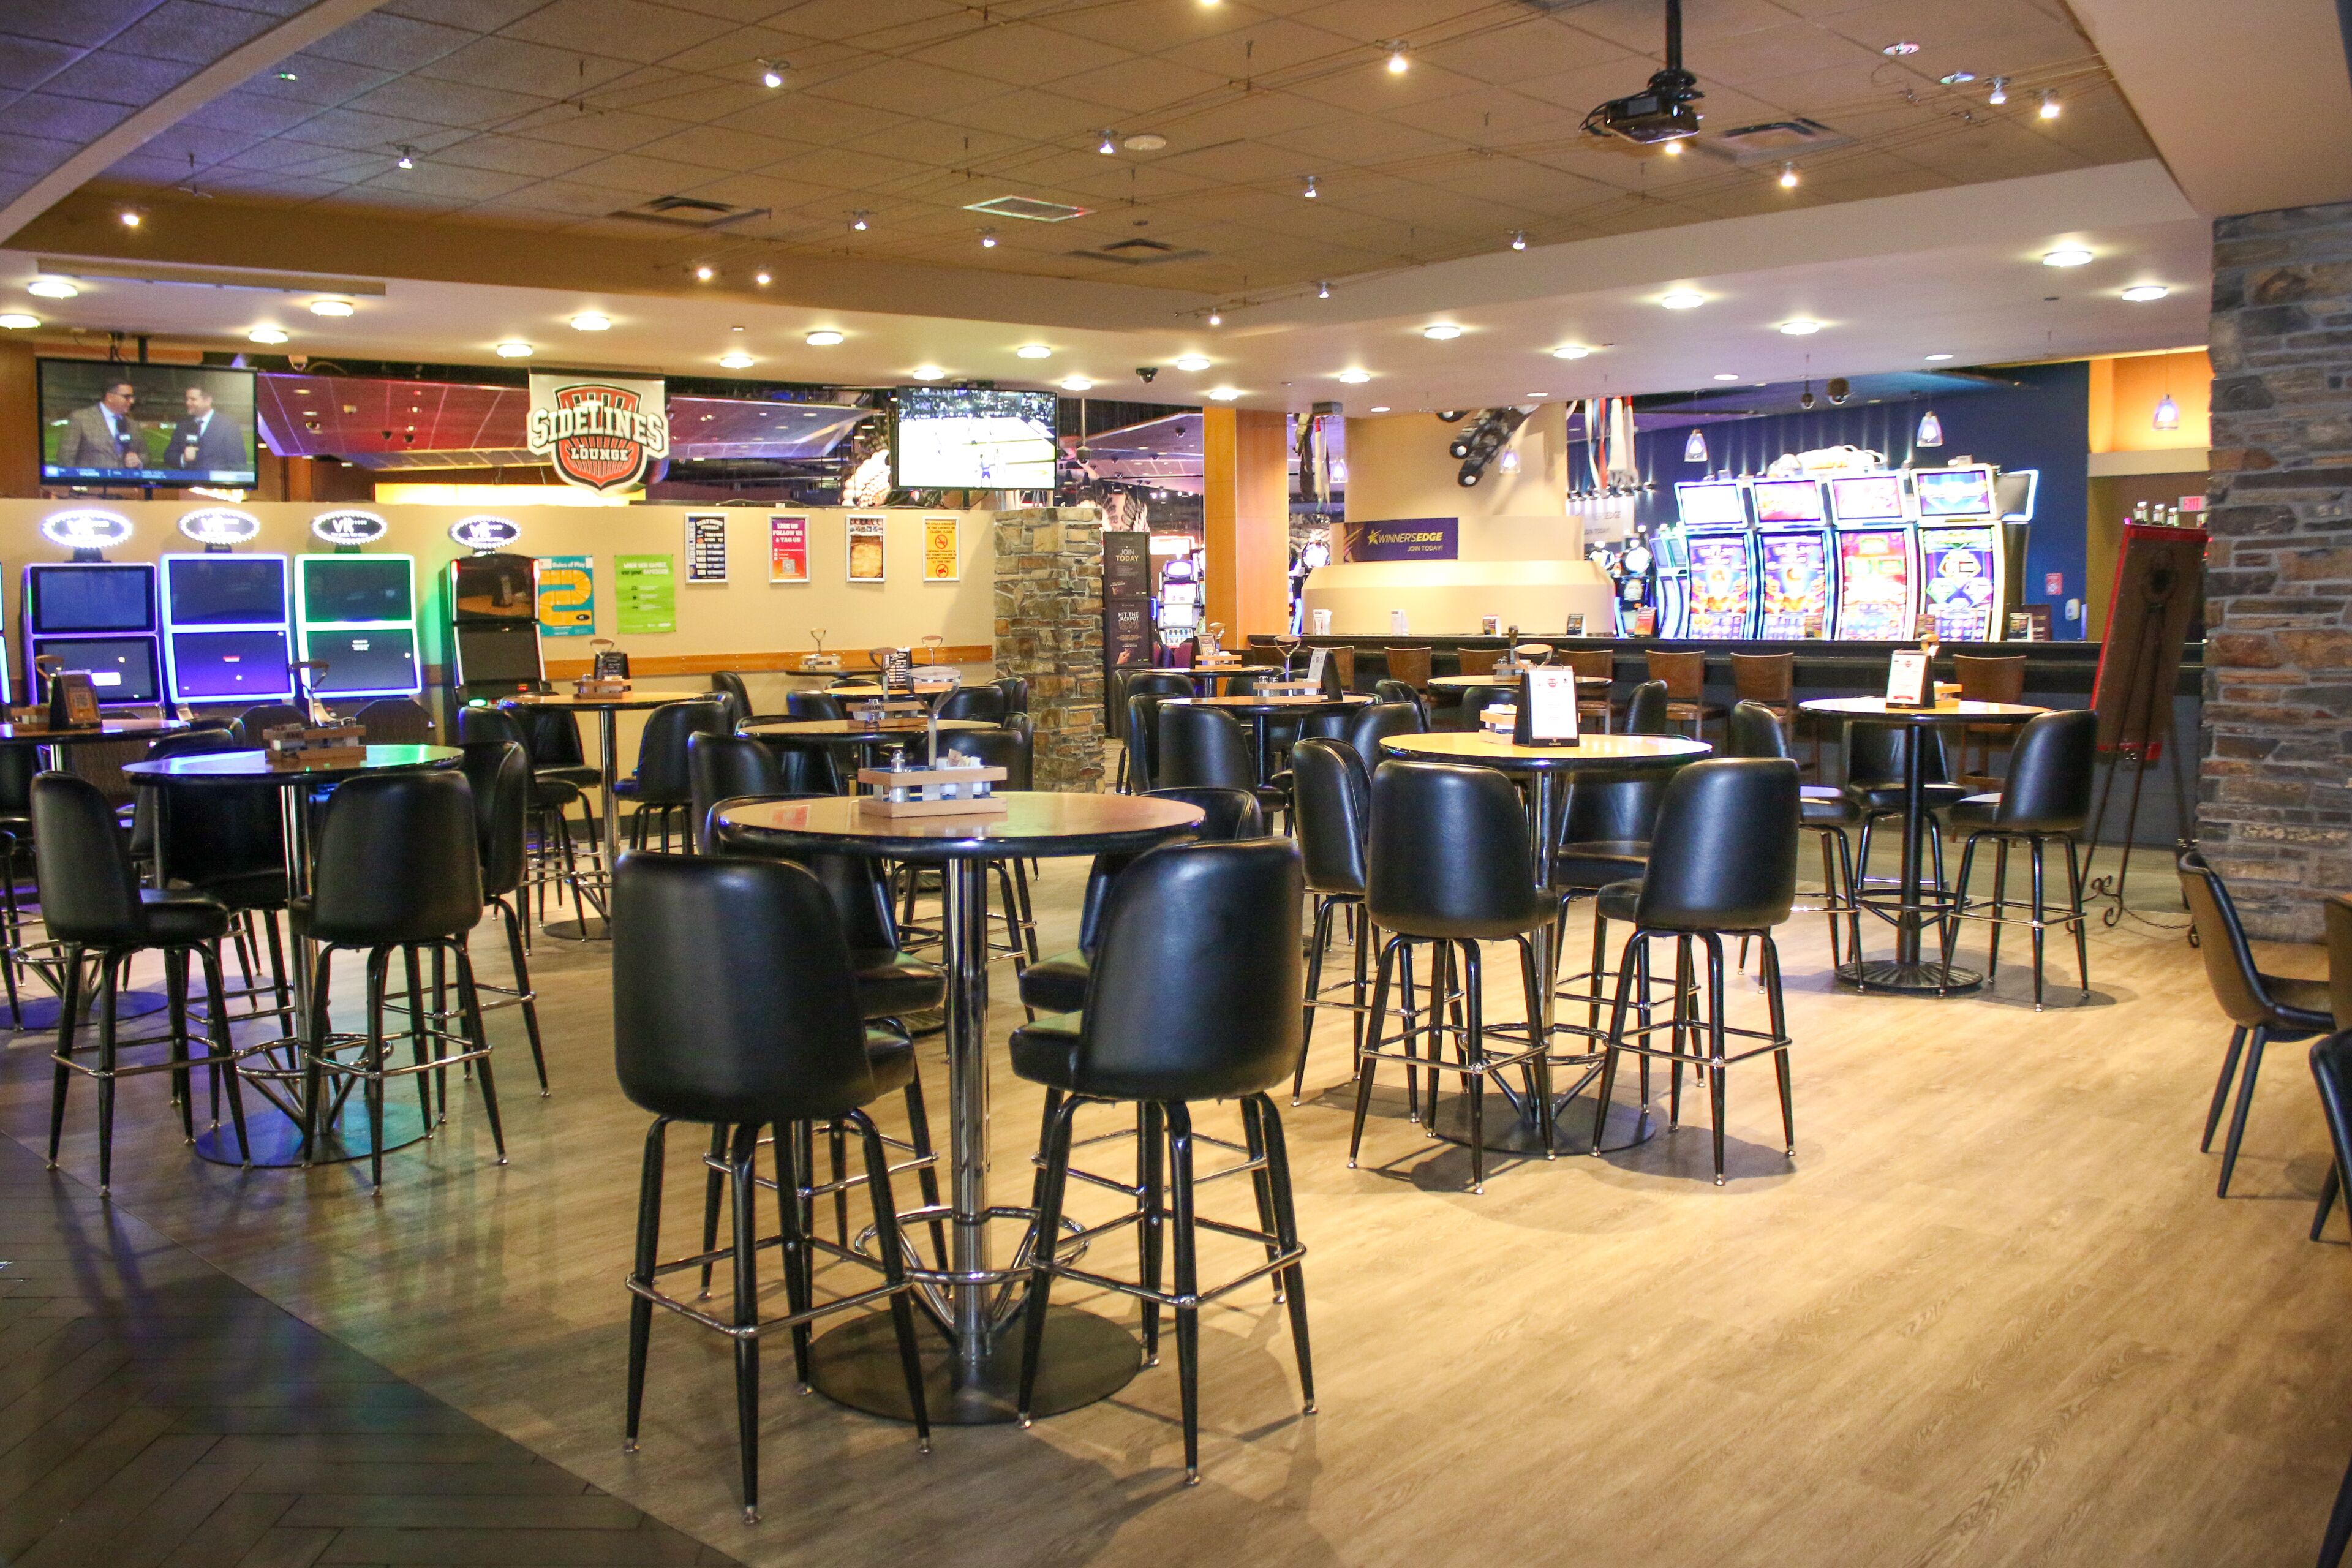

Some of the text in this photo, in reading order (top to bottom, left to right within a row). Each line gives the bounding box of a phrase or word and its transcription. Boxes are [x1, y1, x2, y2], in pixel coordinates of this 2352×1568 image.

[532, 405, 664, 453] SIDELINES
[571, 447, 630, 461] LOUNGE
[2184, 497, 2201, 510] EXIT
